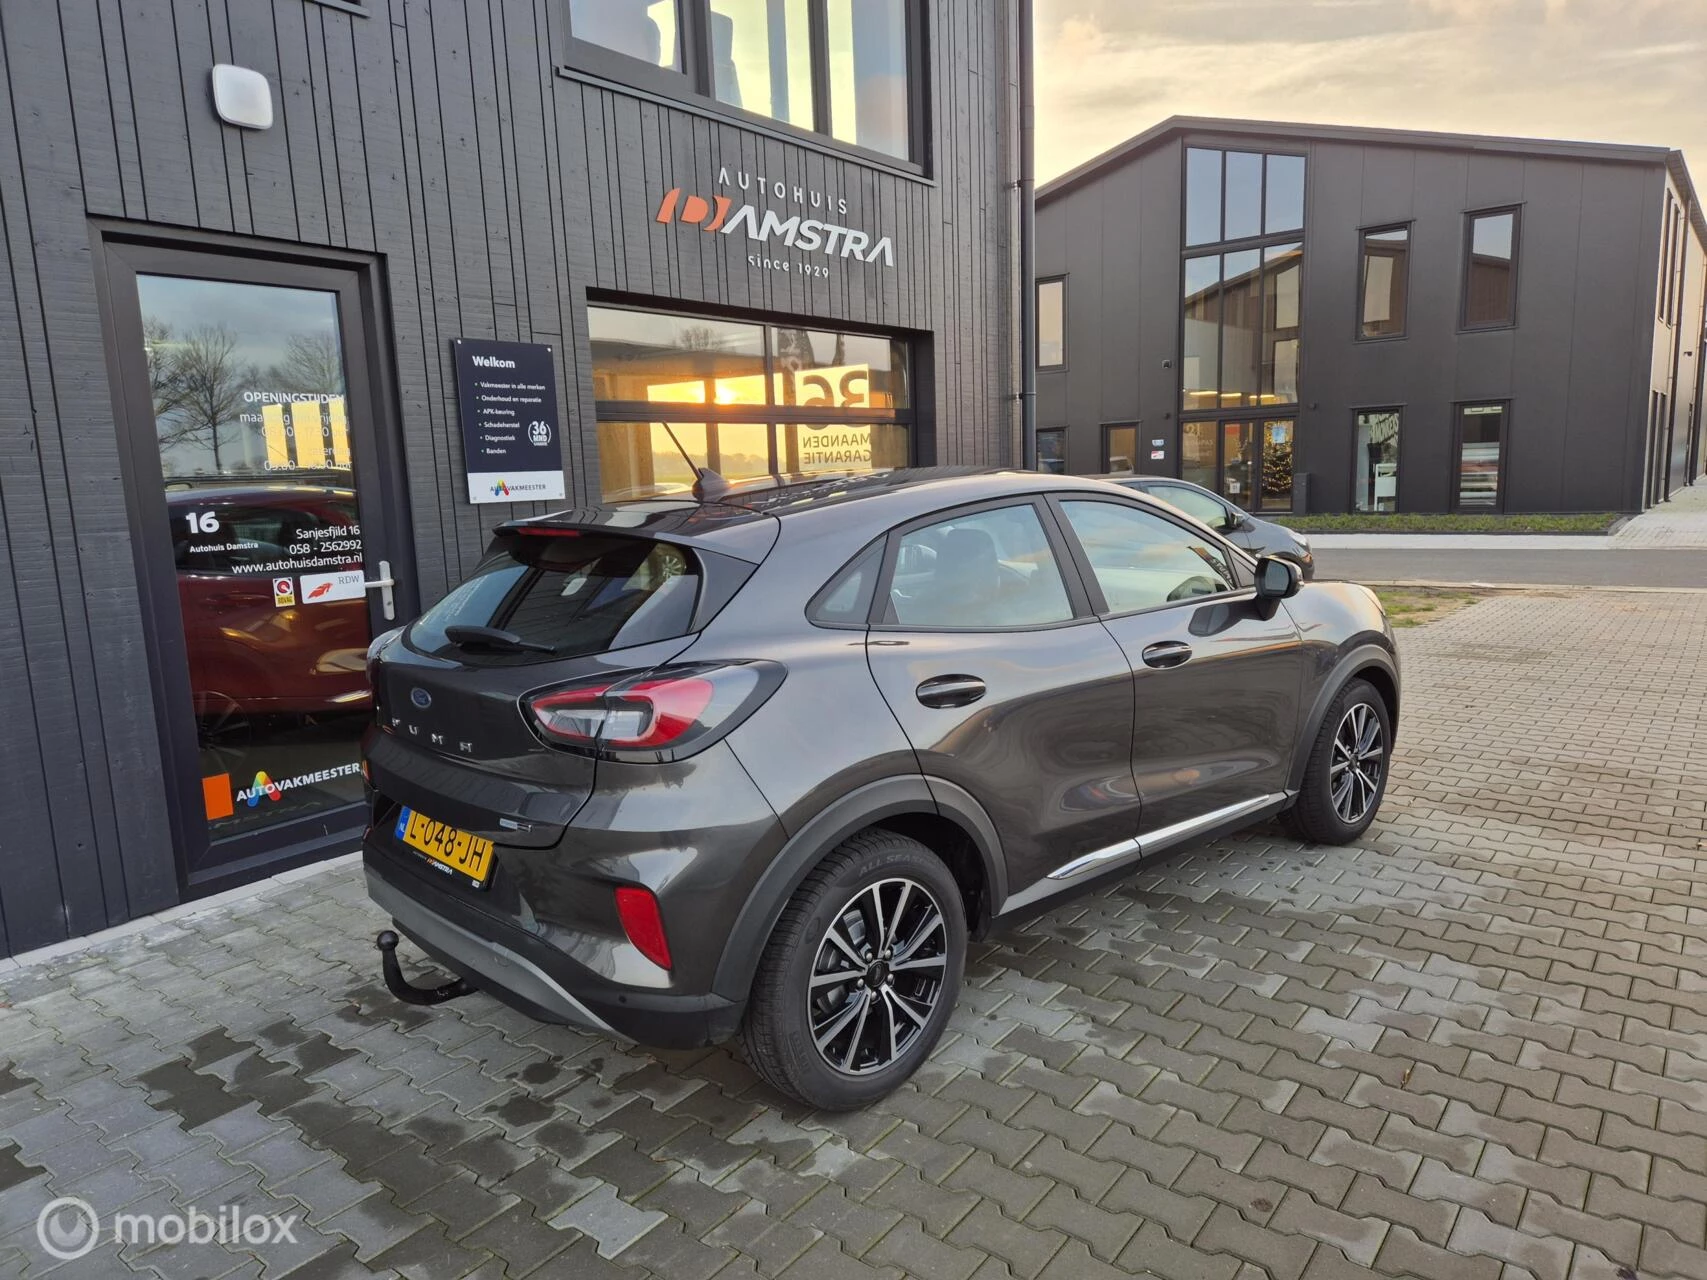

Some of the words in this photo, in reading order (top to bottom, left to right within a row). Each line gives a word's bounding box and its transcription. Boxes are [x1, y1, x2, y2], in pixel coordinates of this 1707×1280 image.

[718, 167, 847, 215] AUTOHUIS
[748, 254, 790, 272] since
[798, 263, 829, 279] 1929
[472, 355, 516, 369] Welkom
[480, 381, 510, 389] Vakmeester
[519, 396, 542, 404] reparatie
[482, 408, 515, 416] APK-keuring
[240, 414, 290, 425] maag
[532, 421, 547, 435] 36
[484, 434, 515, 442] Diagnostiek
[185, 511, 219, 534] 16
[295, 526, 347, 540] Sanjesfjild
[348, 525, 361, 535] 16
[189, 544, 225, 553] Autohuis
[226, 542, 259, 551] Damstra
[289, 544, 311, 555] 058
[320, 539, 362, 553] 2562992
[232, 552, 363, 574] www.autohuisdamstra.nl
[338, 575, 360, 585] RDW
[236, 762, 360, 802] AUTOVAKMEESTER
[410, 813, 487, 872] L-048-JH
